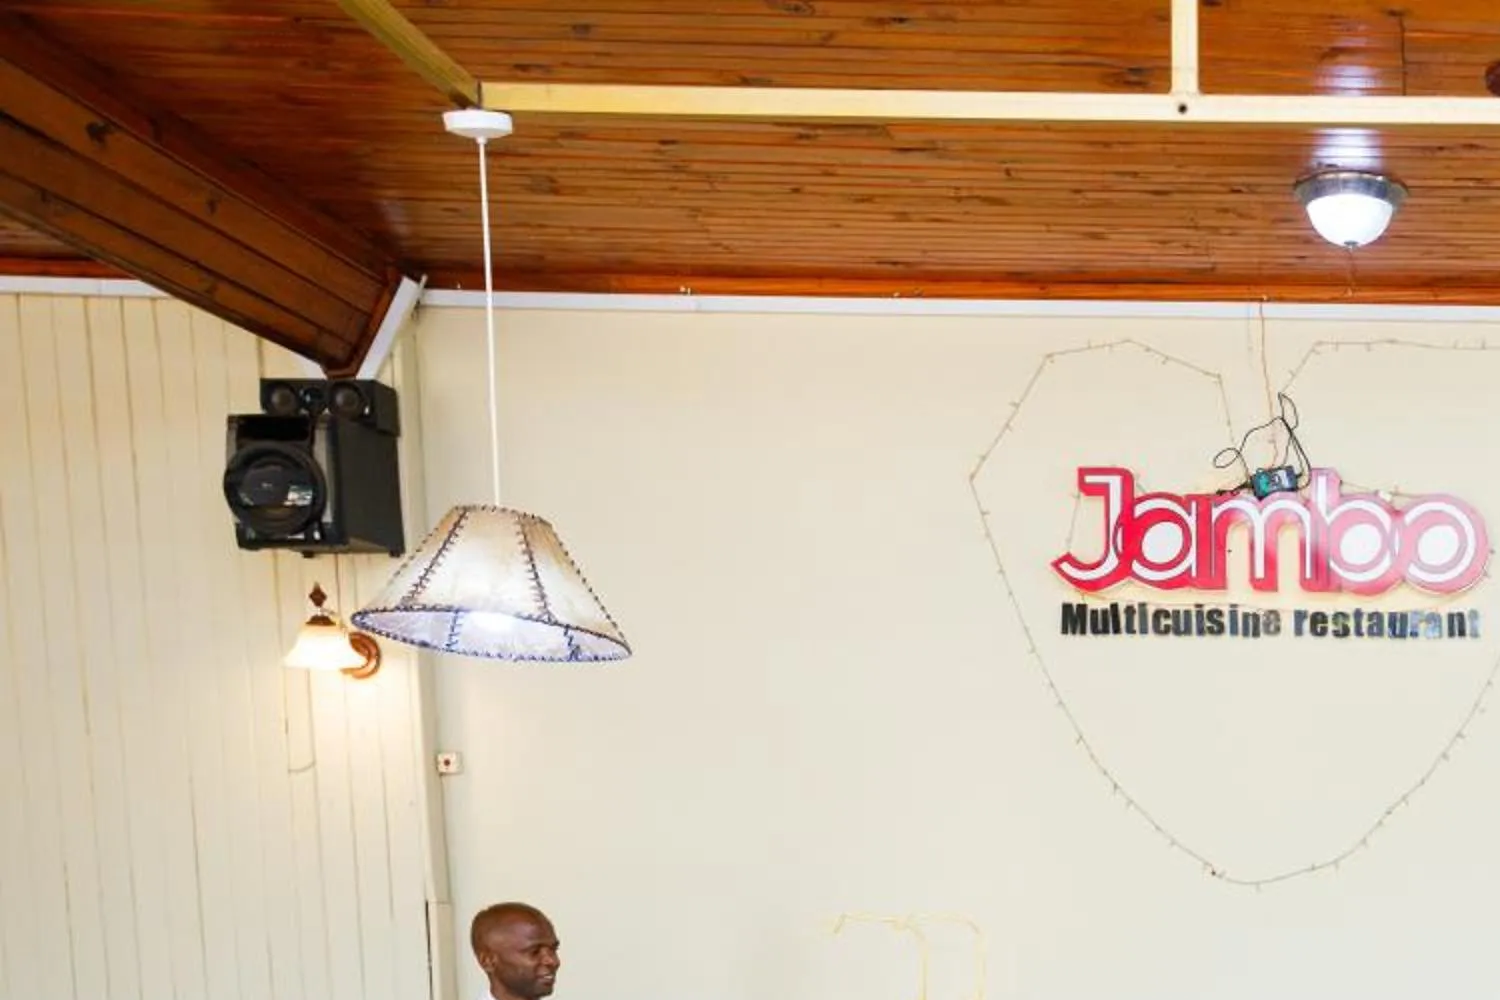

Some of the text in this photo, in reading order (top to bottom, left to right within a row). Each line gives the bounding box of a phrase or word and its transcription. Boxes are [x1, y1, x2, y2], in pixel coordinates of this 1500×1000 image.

[1051, 467, 1489, 594] Jambo
[1060, 602, 1480, 638] Multicuisine restaurant
